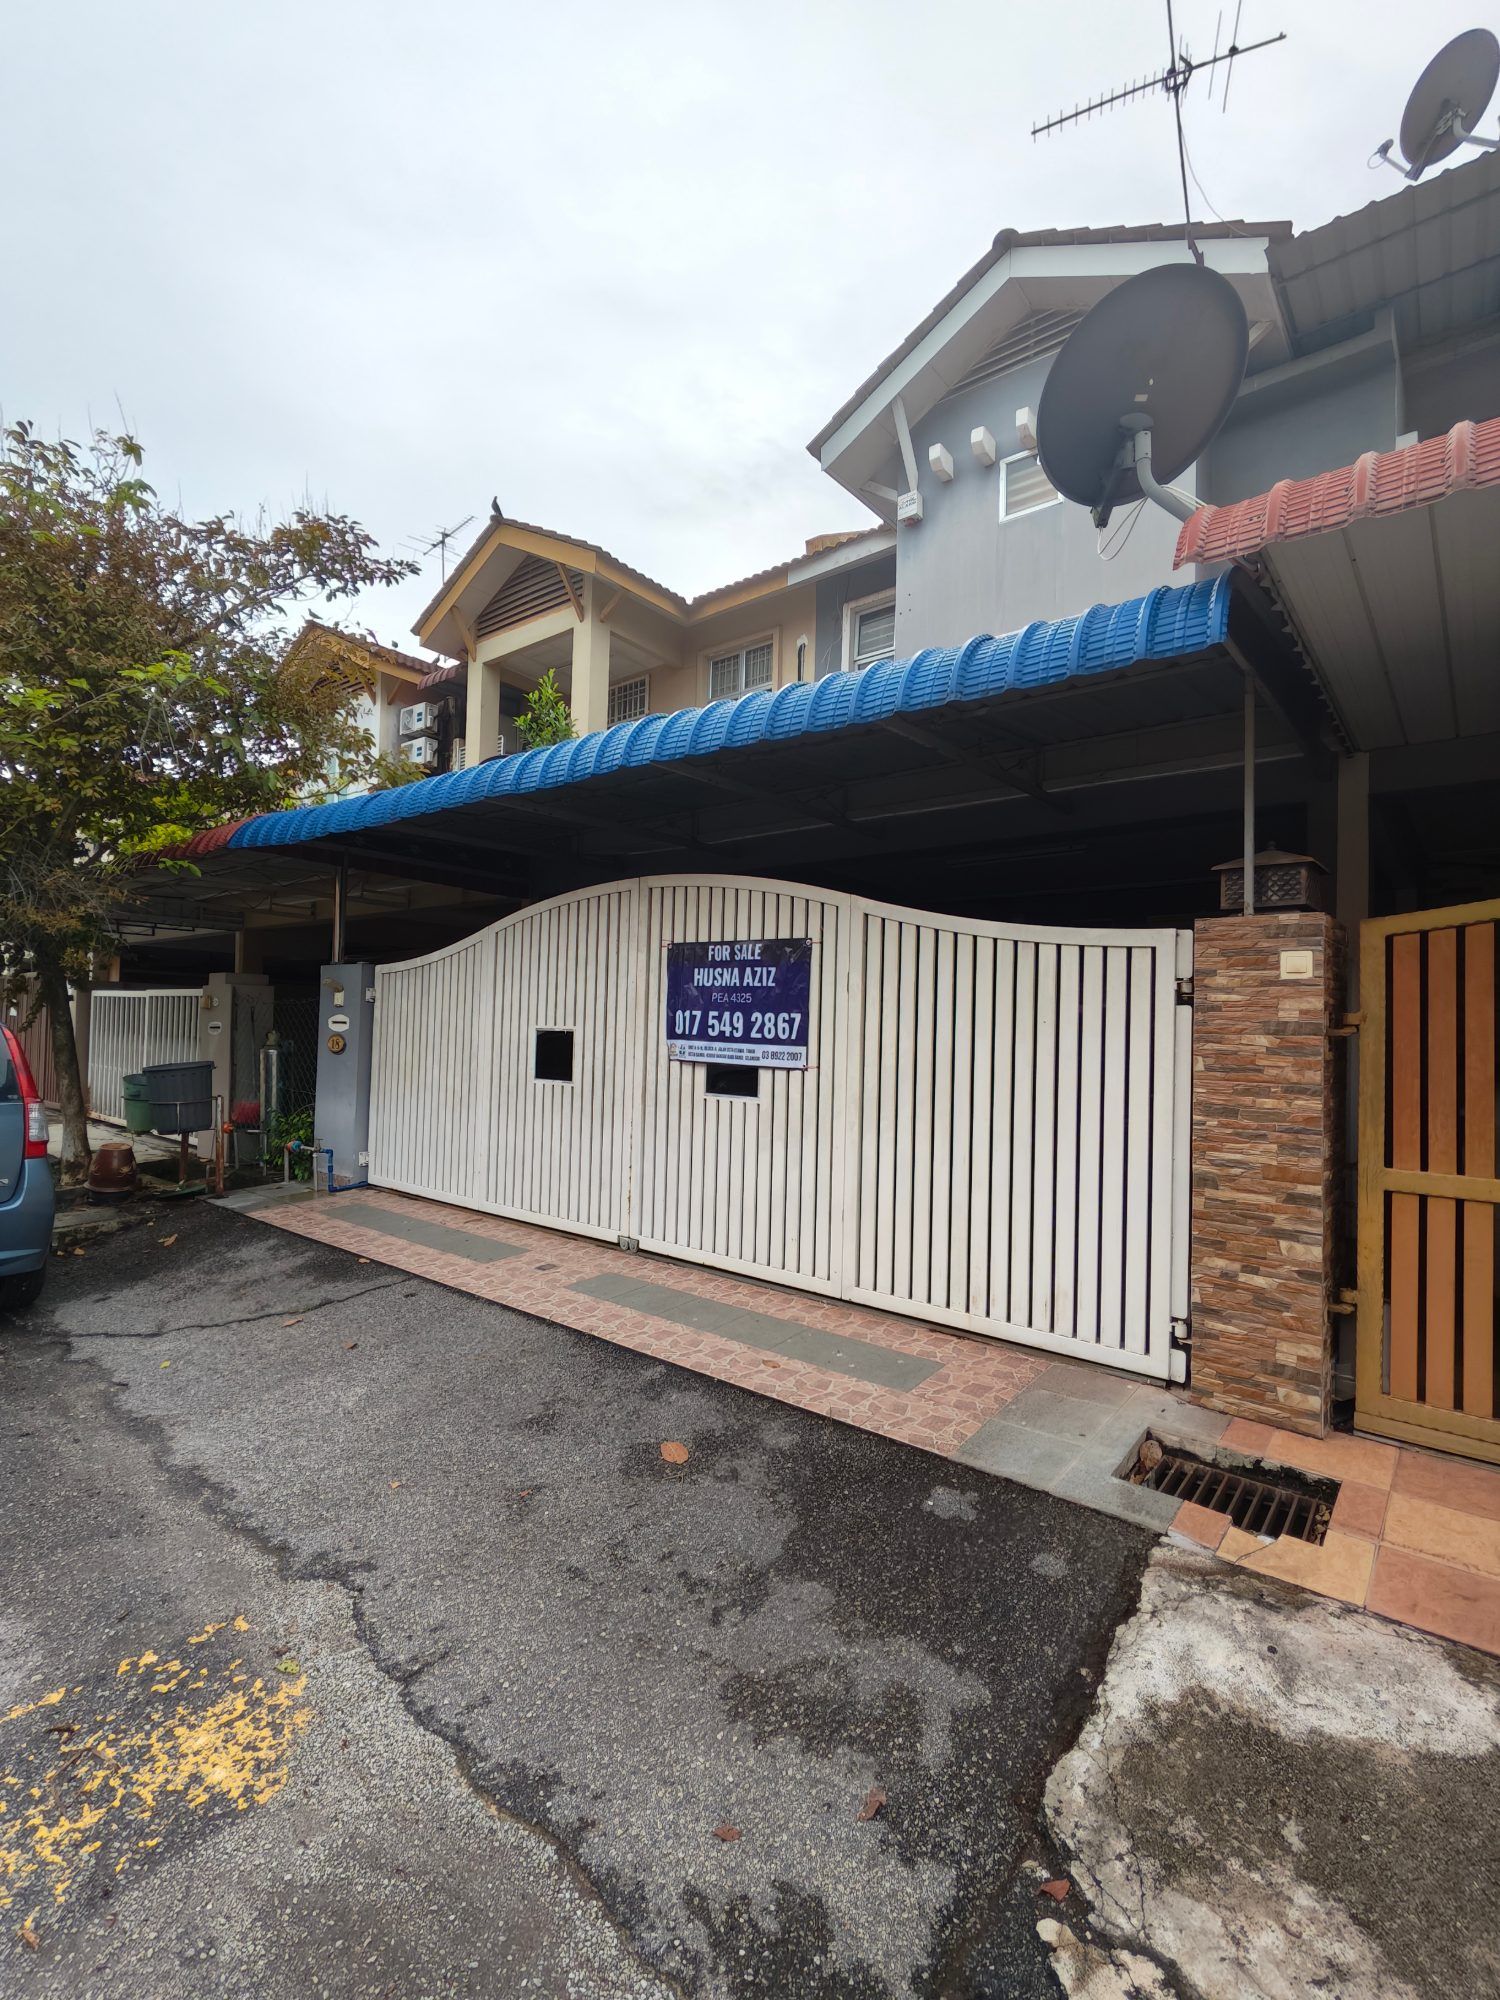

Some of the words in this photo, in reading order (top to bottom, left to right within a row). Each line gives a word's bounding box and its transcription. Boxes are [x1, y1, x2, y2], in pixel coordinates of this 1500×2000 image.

[708, 945, 731, 961] FOR
[735, 943, 762, 960] SALE
[694, 967, 740, 987] HUSNA
[743, 967, 776, 987] AZIZ
[711, 992, 729, 1003] PEA
[730, 992, 752, 1003] 4325
[675, 1009, 701, 1035] 017
[707, 1010, 744, 1038] 549
[750, 1012, 801, 1040] 2867
[761, 1050, 769, 1060] 03
[770, 1051, 786, 1061] 8922
[786, 1052, 802, 1062] 2007
